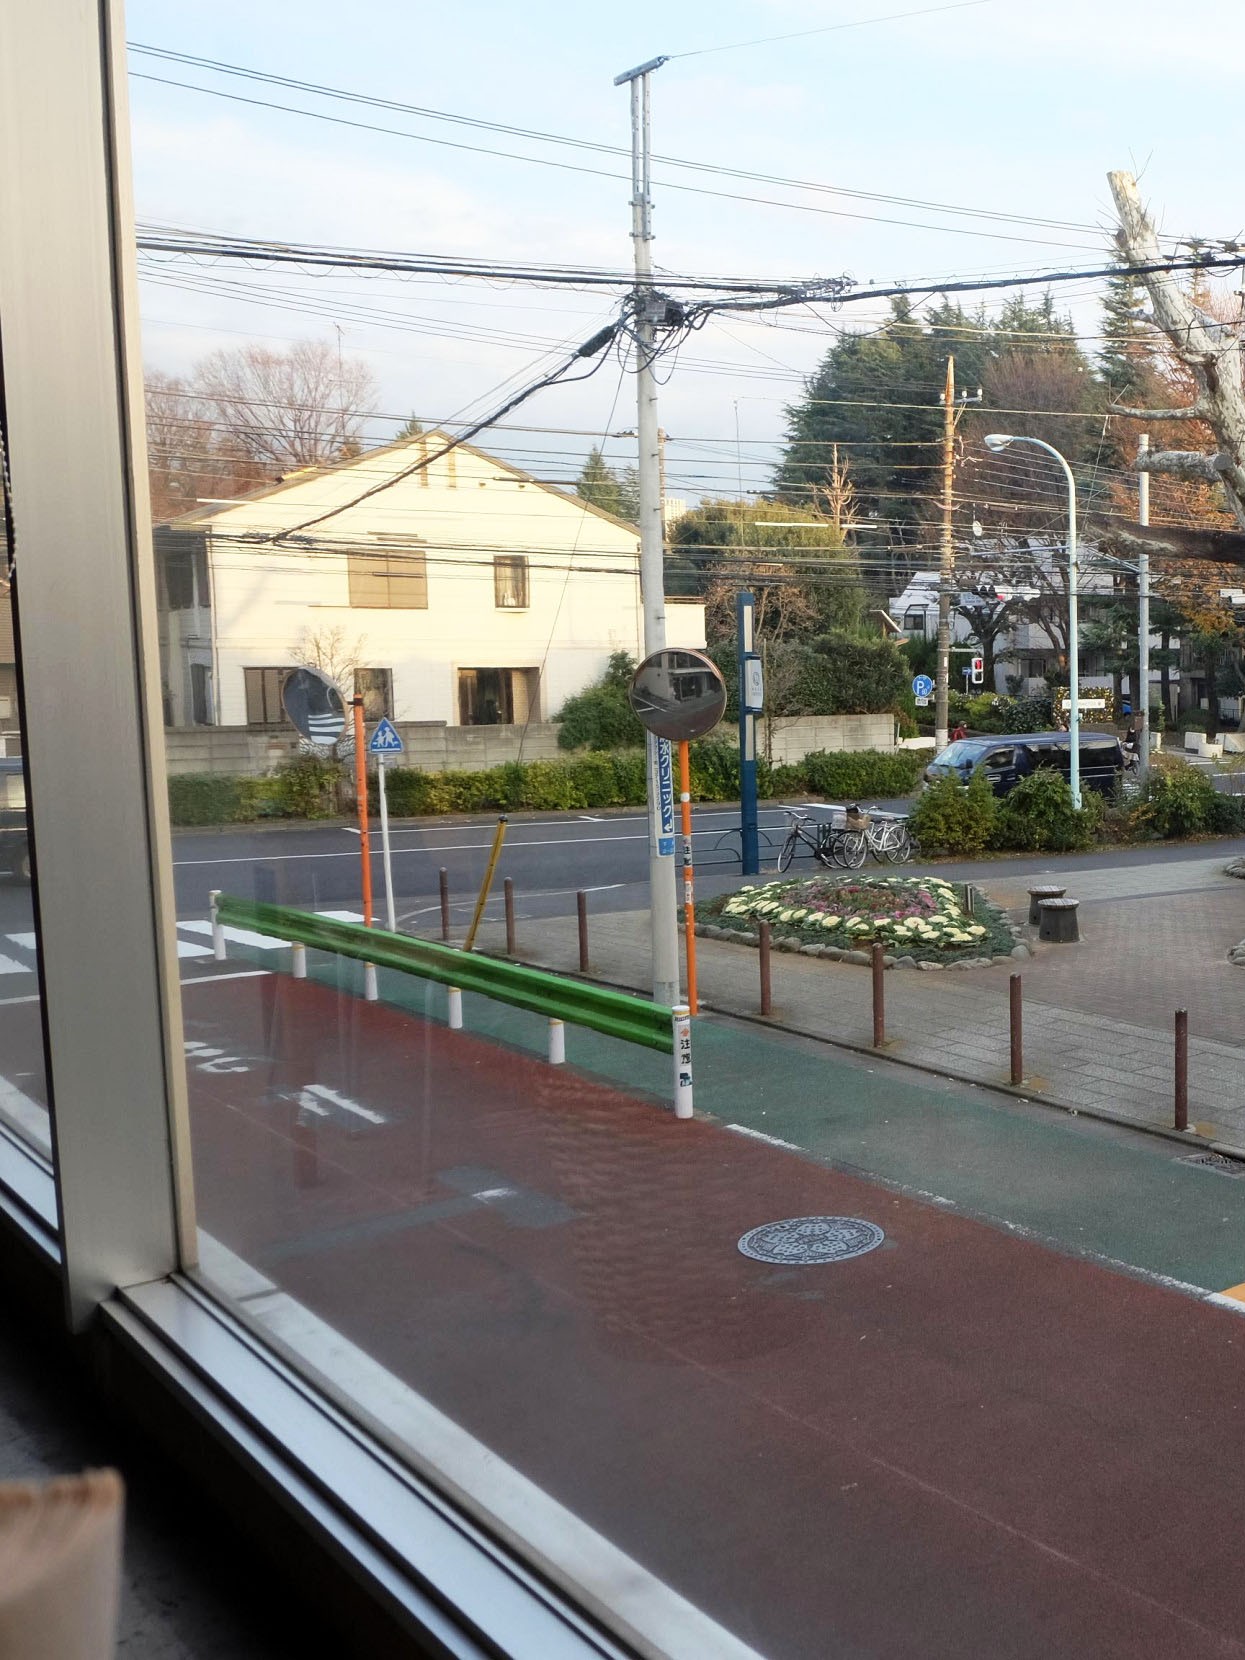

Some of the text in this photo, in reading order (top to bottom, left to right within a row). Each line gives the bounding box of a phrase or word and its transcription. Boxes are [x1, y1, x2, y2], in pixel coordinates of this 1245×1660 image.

[916, 680, 925, 694] P
[659, 738, 673, 818] 水クリニック
